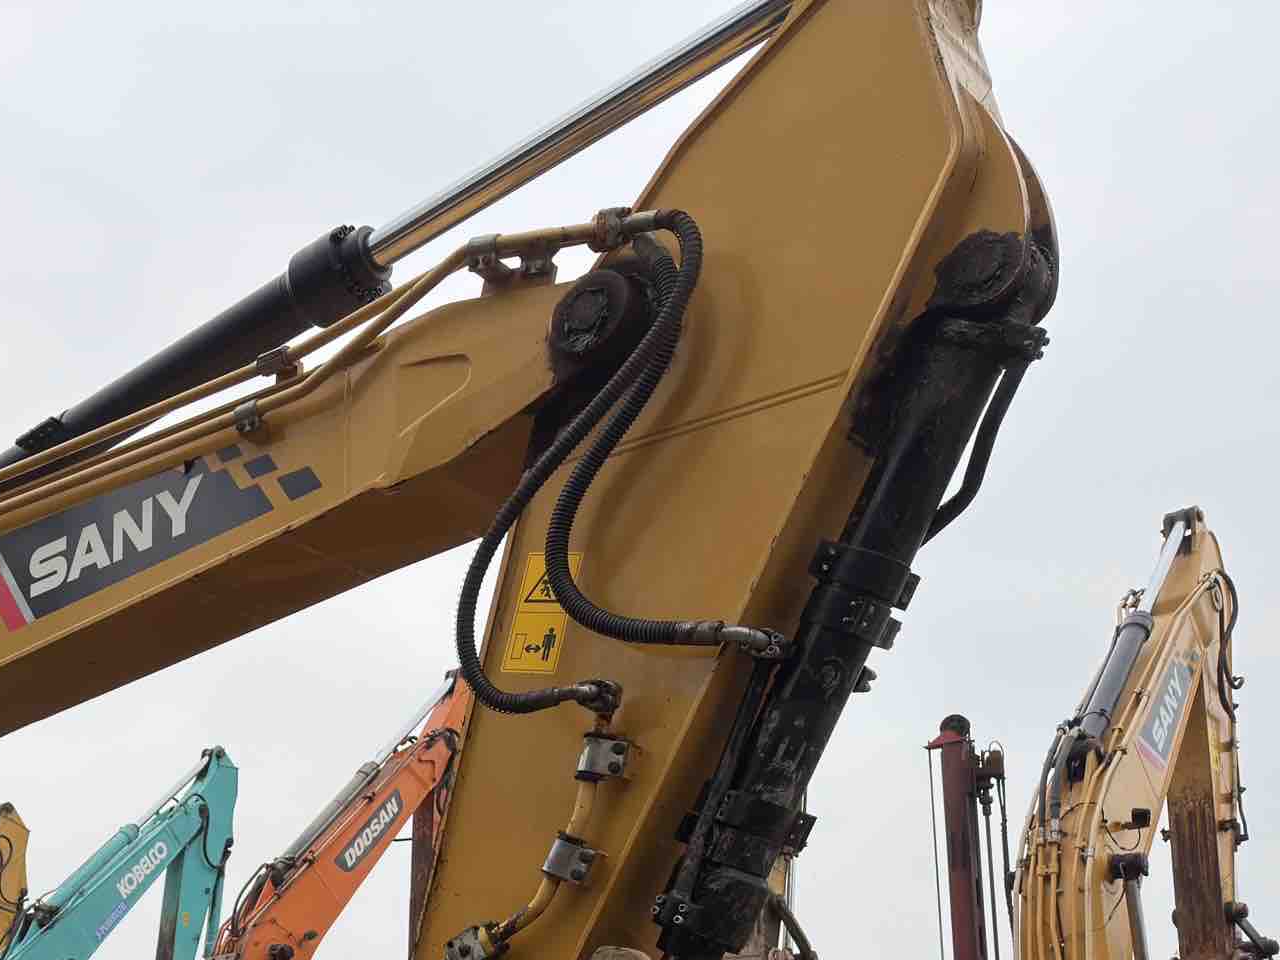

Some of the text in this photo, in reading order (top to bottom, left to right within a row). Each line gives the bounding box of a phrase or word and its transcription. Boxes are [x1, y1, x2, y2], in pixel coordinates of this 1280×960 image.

[28, 473, 203, 599] SANY
[1152, 665, 1182, 753] SANY
[116, 841, 168, 899] KOBELCO
[343, 796, 399, 868] DOOSAN
